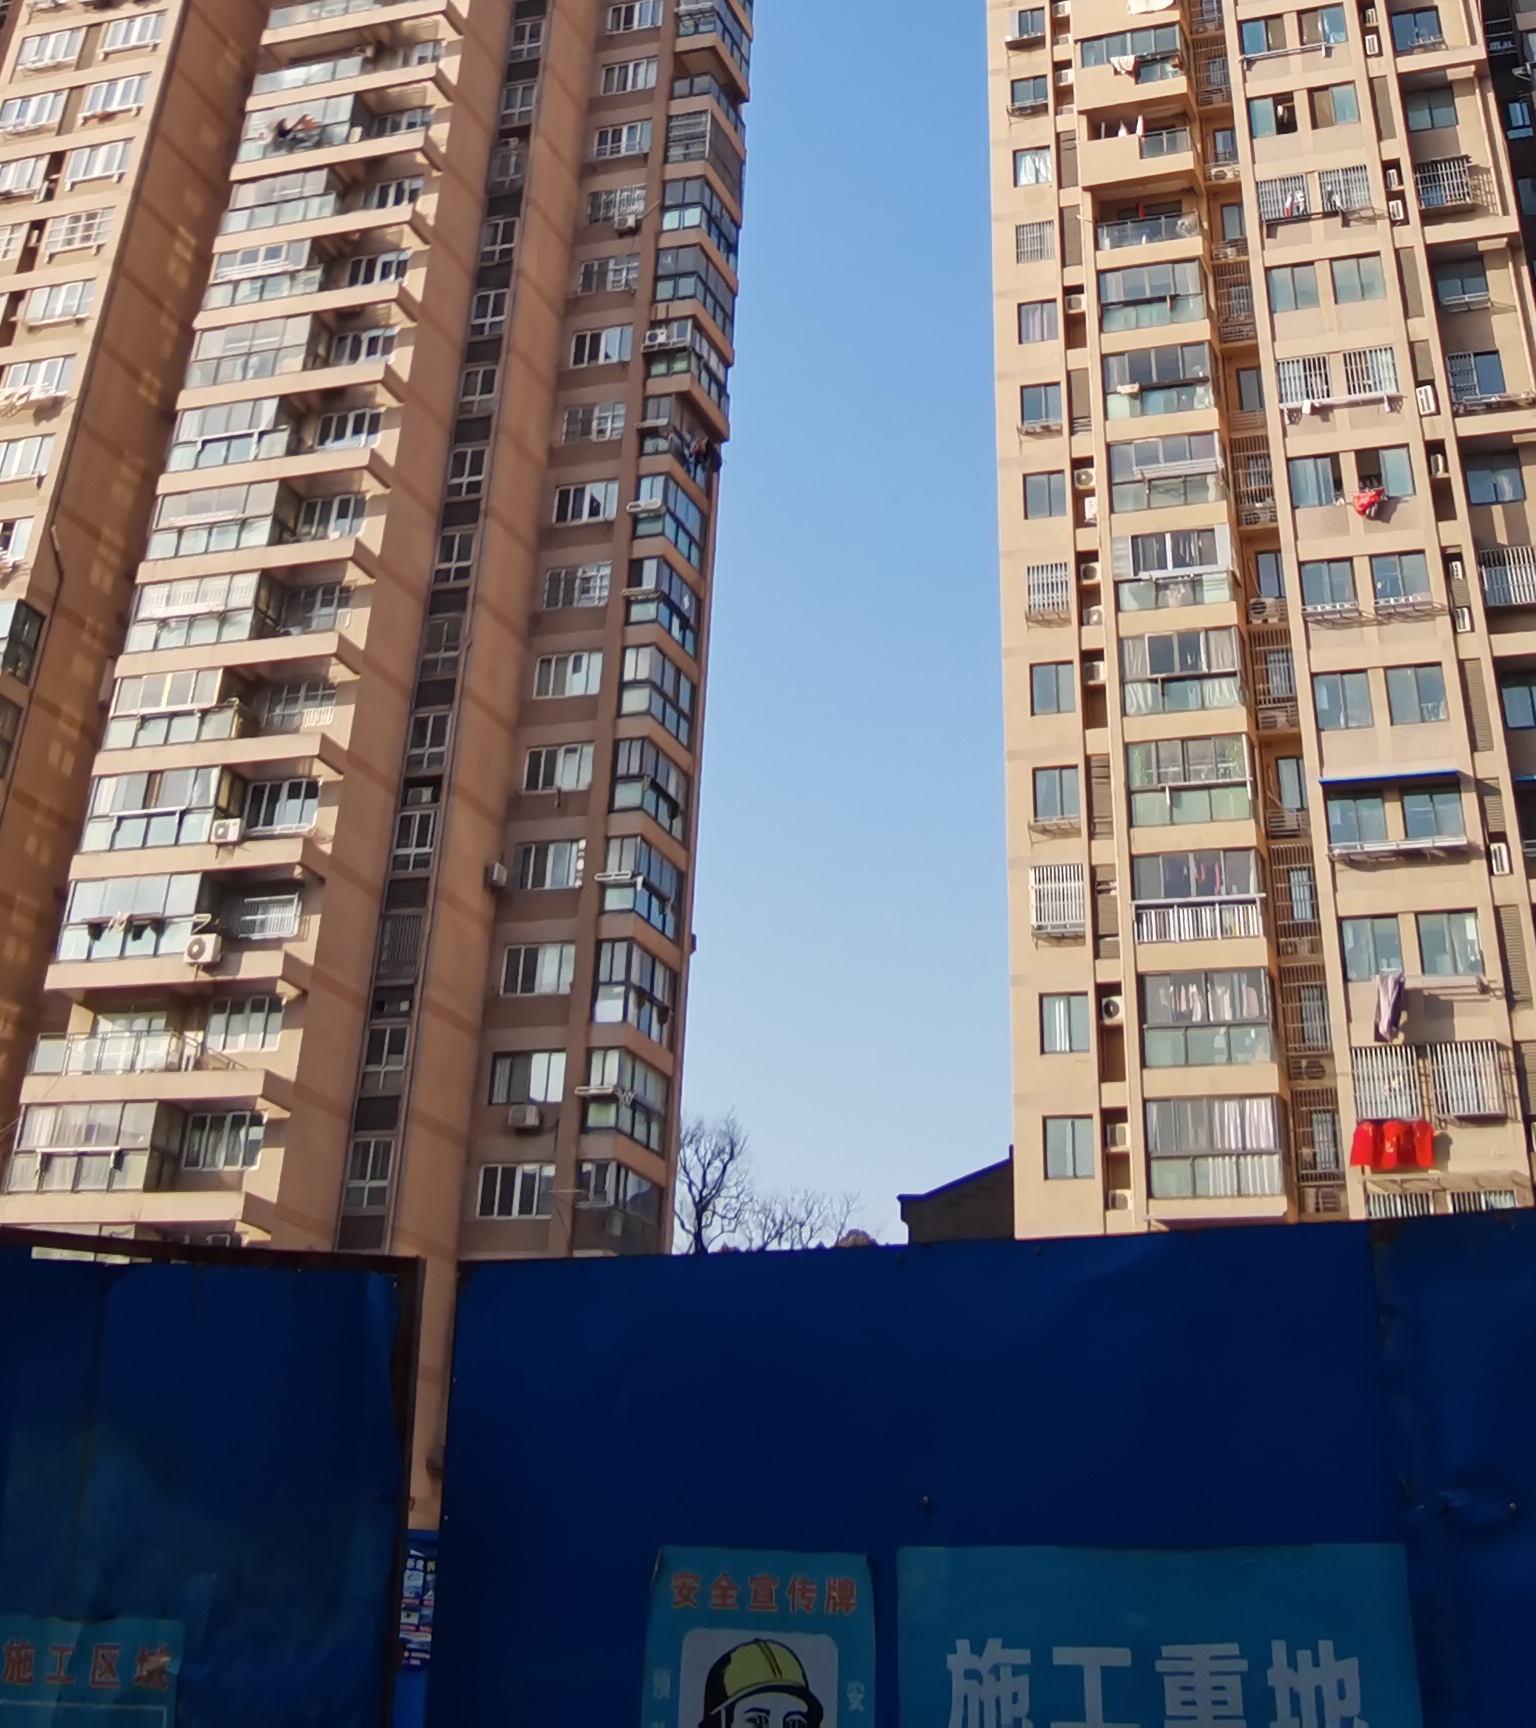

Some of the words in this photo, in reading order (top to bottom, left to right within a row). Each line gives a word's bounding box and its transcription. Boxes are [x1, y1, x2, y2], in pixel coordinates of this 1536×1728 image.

[670, 1569, 857, 1615] 安全宣传牌
[0, 1637, 171, 1690] 施工区域
[946, 1637, 1370, 1728] 施工重地
